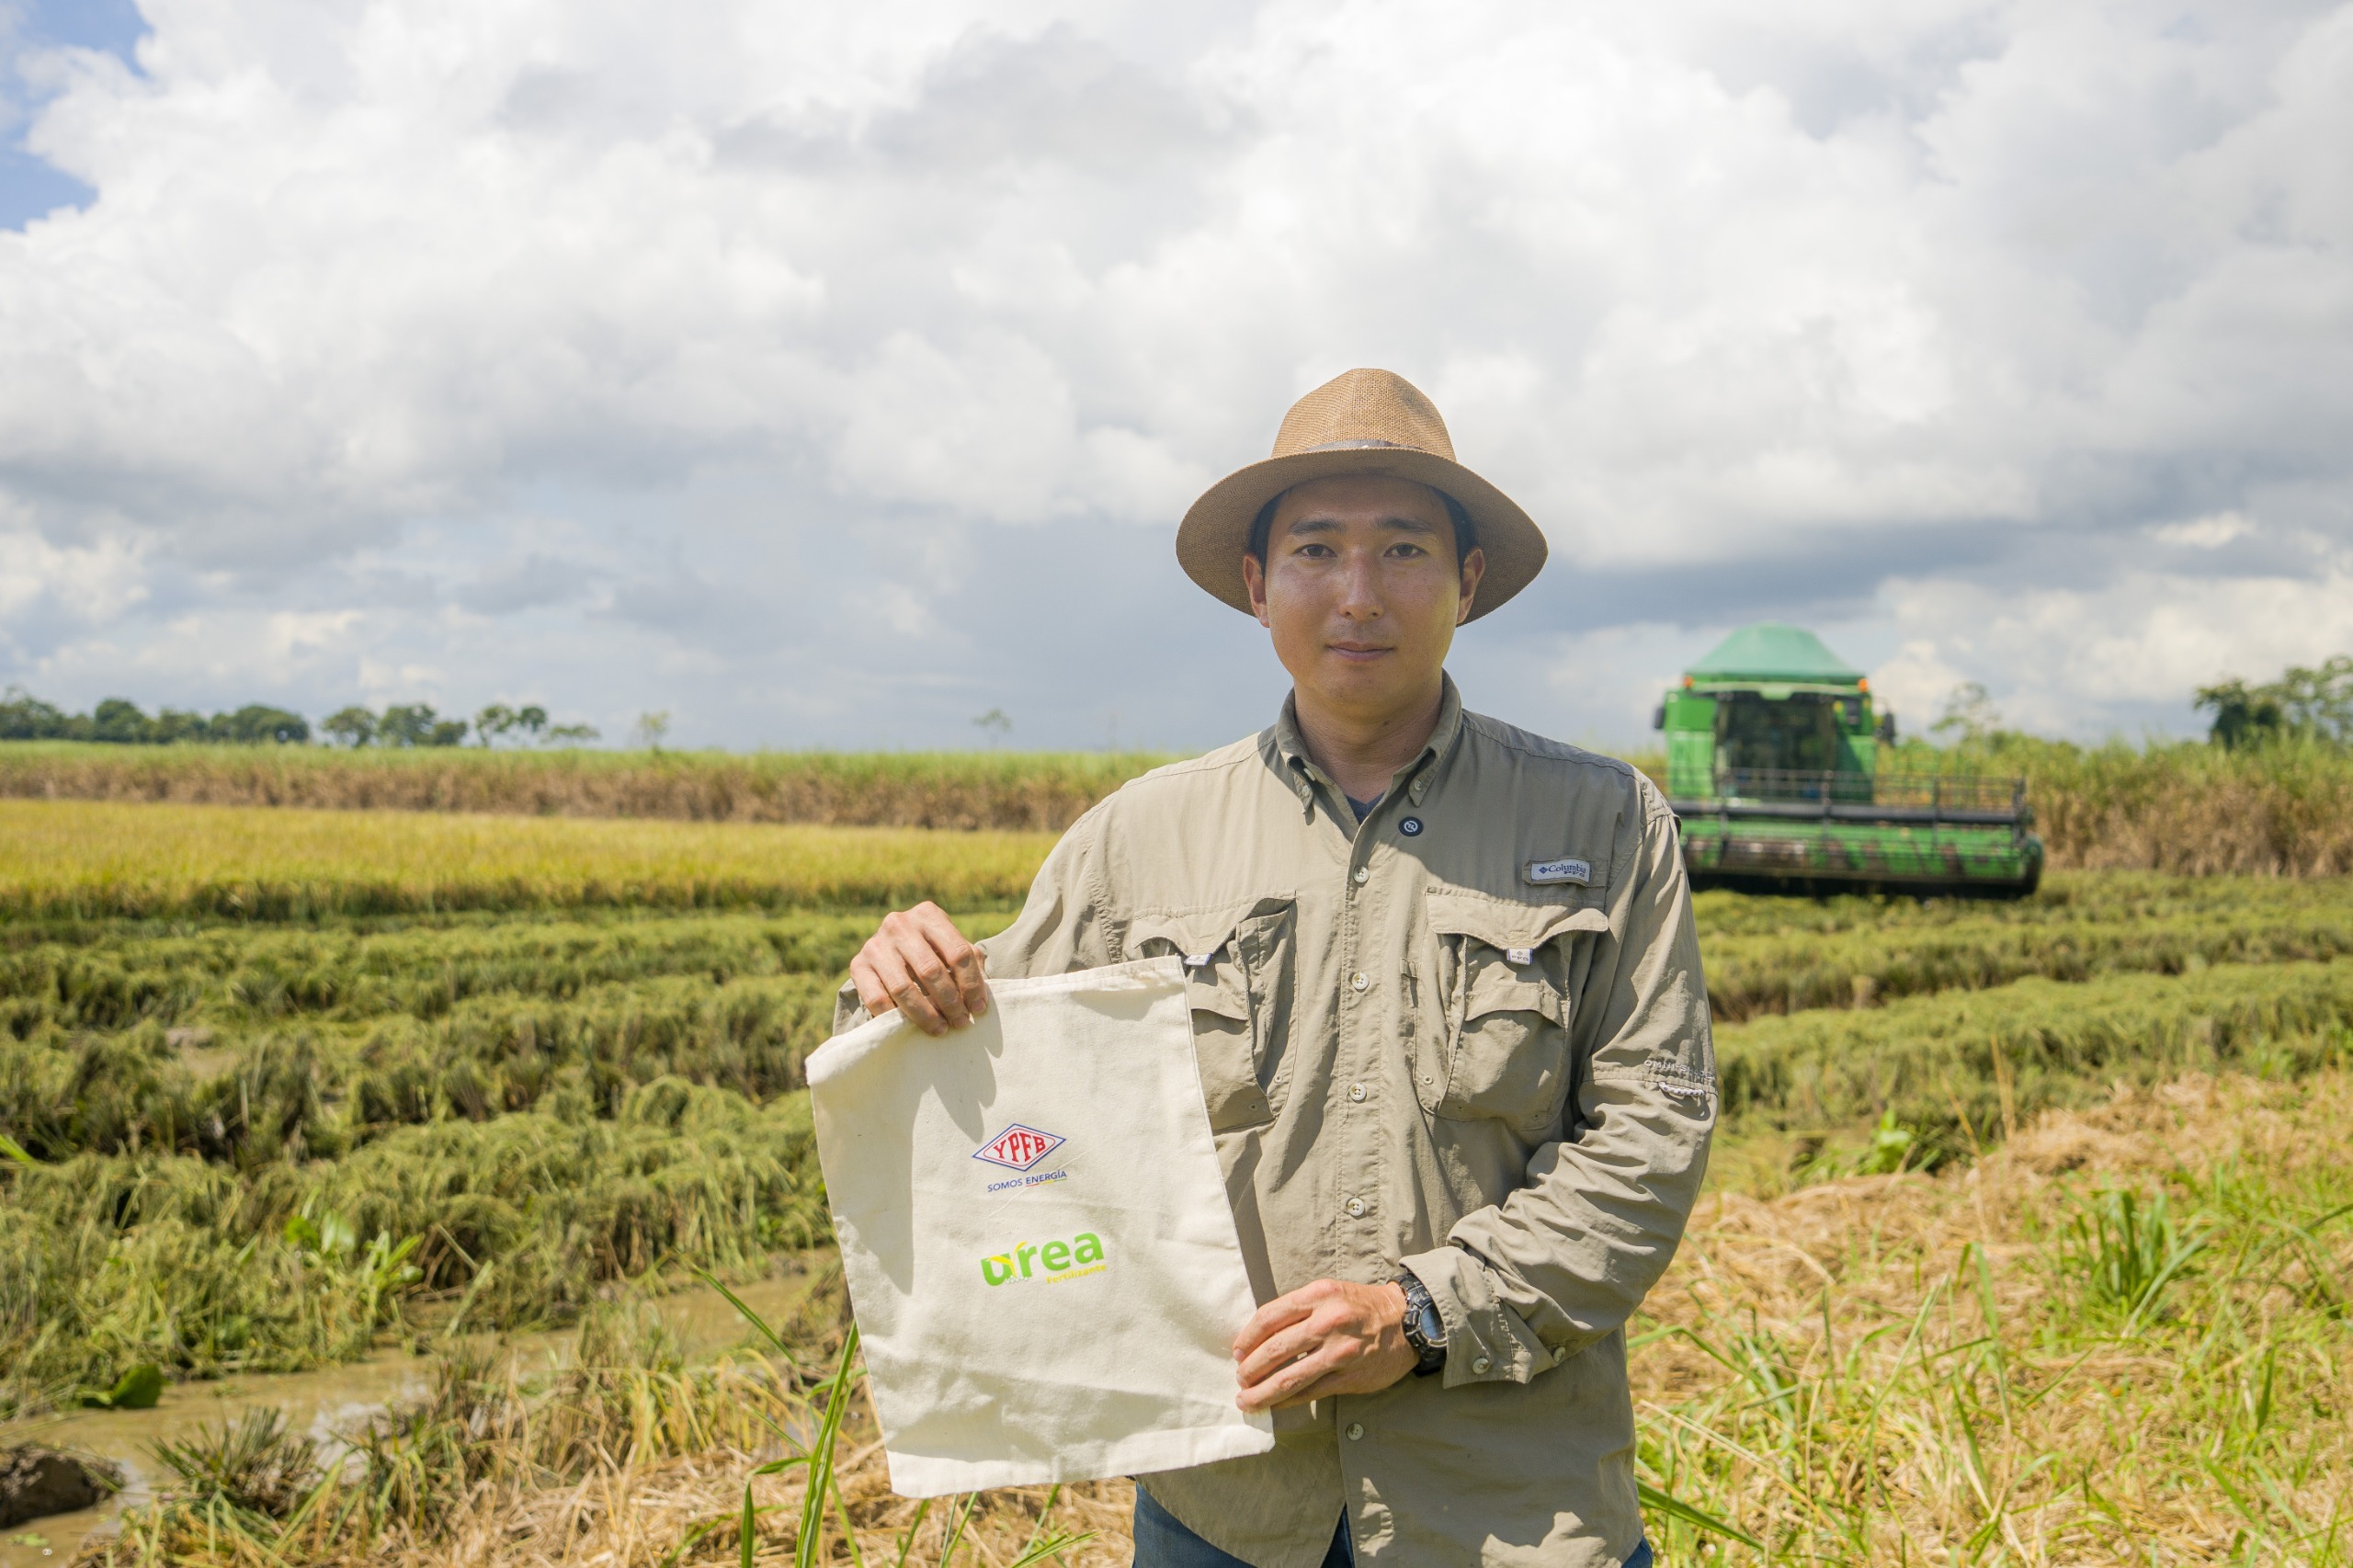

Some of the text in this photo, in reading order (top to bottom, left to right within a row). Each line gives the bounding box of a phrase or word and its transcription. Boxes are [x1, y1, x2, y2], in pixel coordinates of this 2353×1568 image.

[1548, 863, 1586, 873] Columbia
[994, 1132, 1046, 1163] YPFB
[987, 1170, 1067, 1192] SOMOS ENERGÍA
[980, 1233, 1105, 1287] urea
